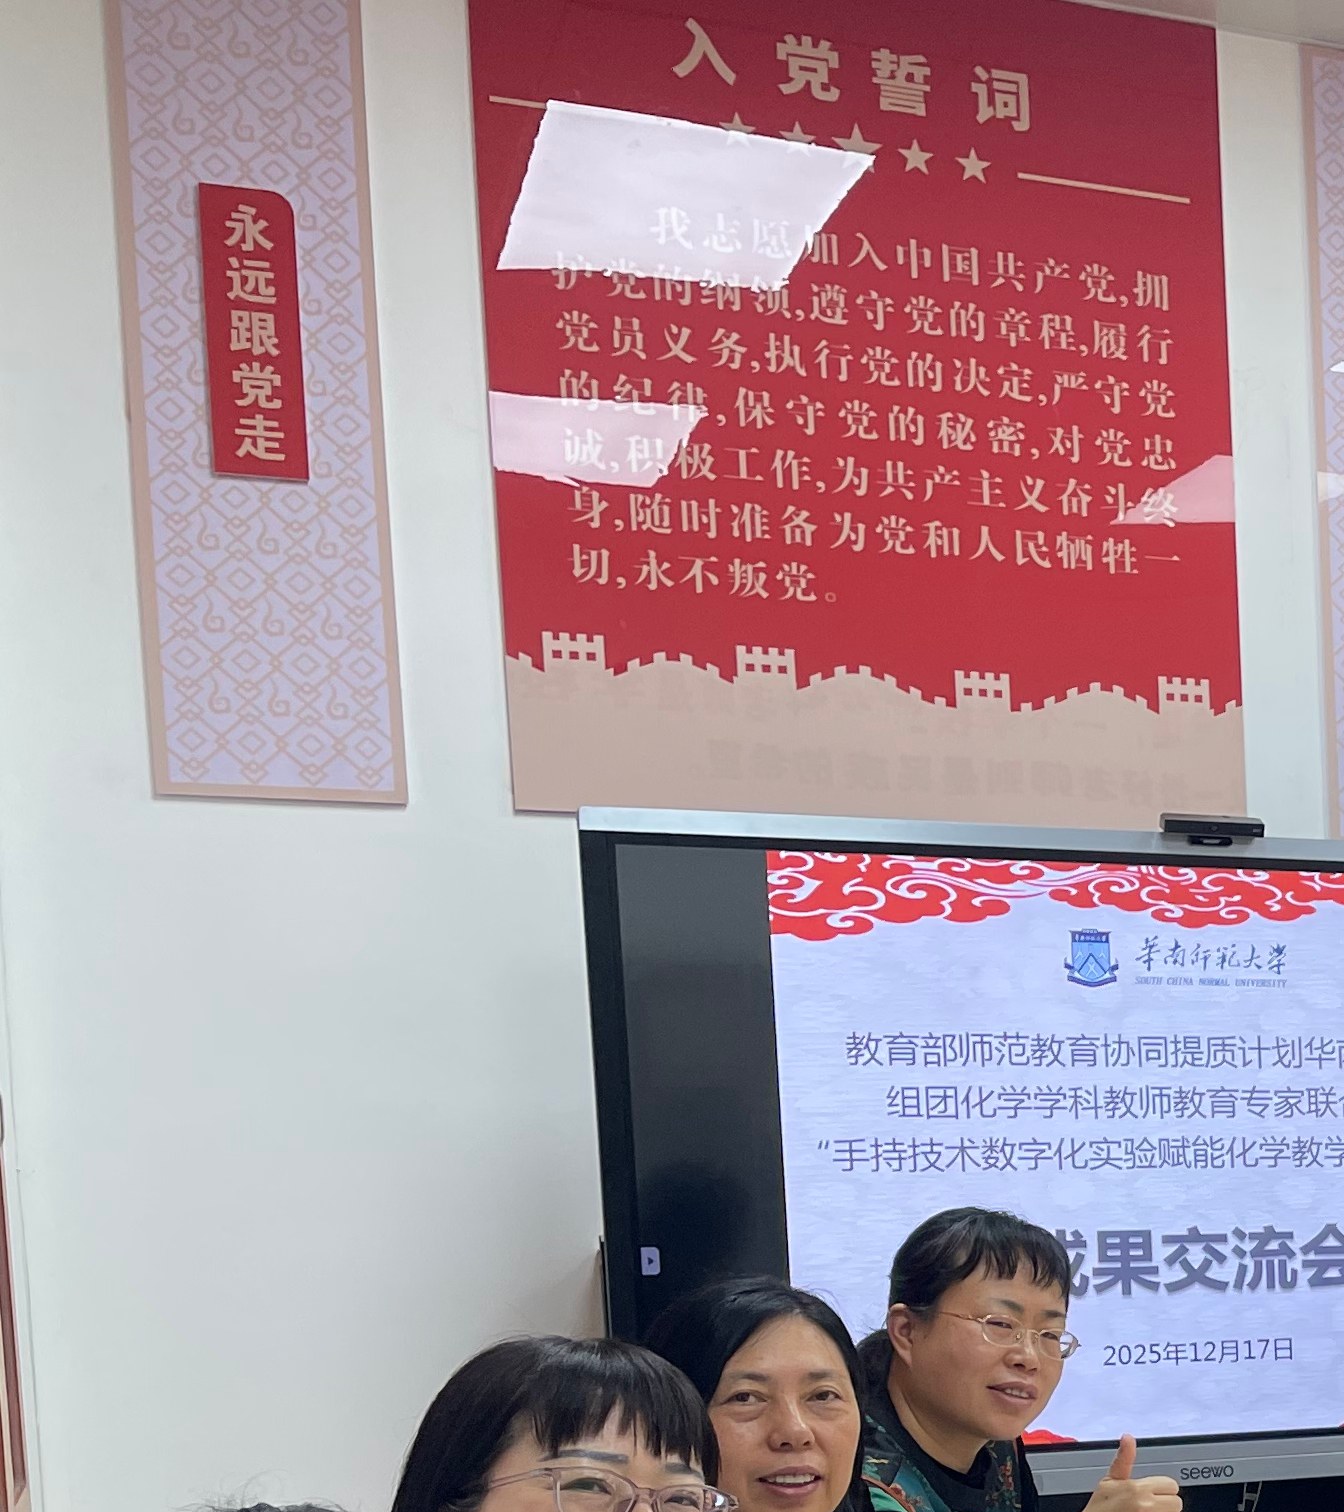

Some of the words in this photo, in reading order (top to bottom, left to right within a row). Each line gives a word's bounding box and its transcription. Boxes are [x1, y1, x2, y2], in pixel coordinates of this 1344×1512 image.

[672, 17, 1032, 132] 入党誓词
[223, 203, 288, 464] 永远跟党走
[554, 310, 1178, 420] 党员义务，执行党的决定，严守党
[558, 366, 1179, 473] 的纪律，保守党的秘密，对党忠
[566, 482, 1181, 576] 身，随时准备为党和人民牺牲一
[568, 540, 840, 604] 切，永不叛党。
[1166, 977, 1194, 986] CHINA
[1235, 979, 1287, 988] UNIVERSITY
[1102, 1337, 1294, 1366] 2025年12月17日
[1180, 1465, 1234, 1480] seewo
